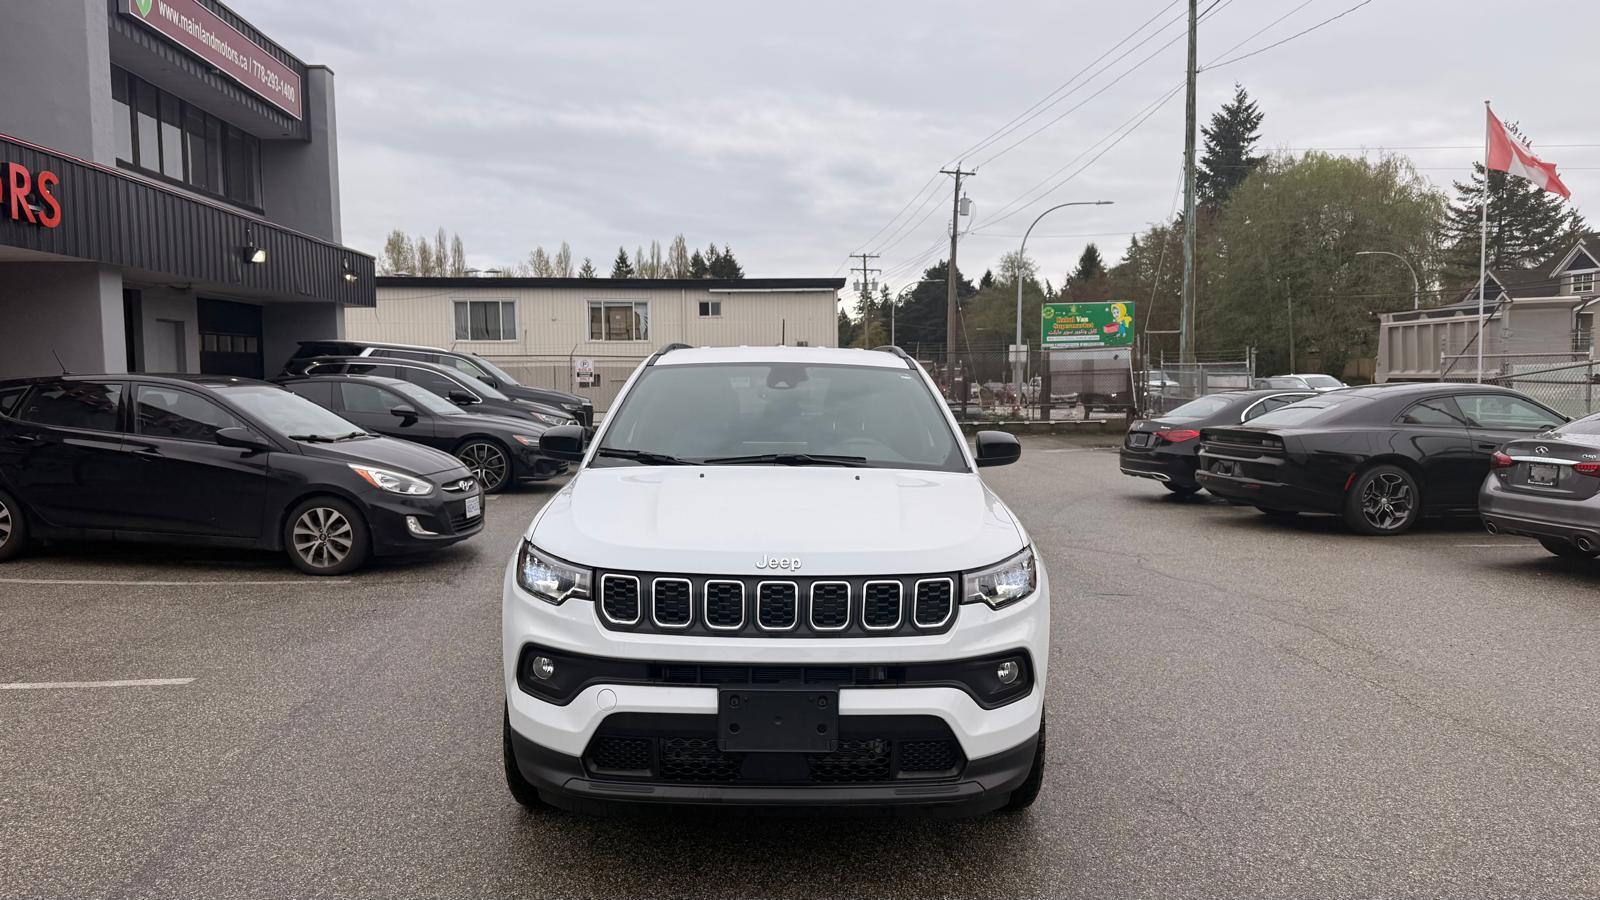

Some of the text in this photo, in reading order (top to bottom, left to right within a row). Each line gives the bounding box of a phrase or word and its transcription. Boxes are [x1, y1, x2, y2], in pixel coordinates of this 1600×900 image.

[158, 0, 248, 70] www.mainlandmotors.ca
[253, 60, 295, 102] 778-293-1400
[0, 162, 61, 228] RS
[755, 554, 802, 572] Jeep
